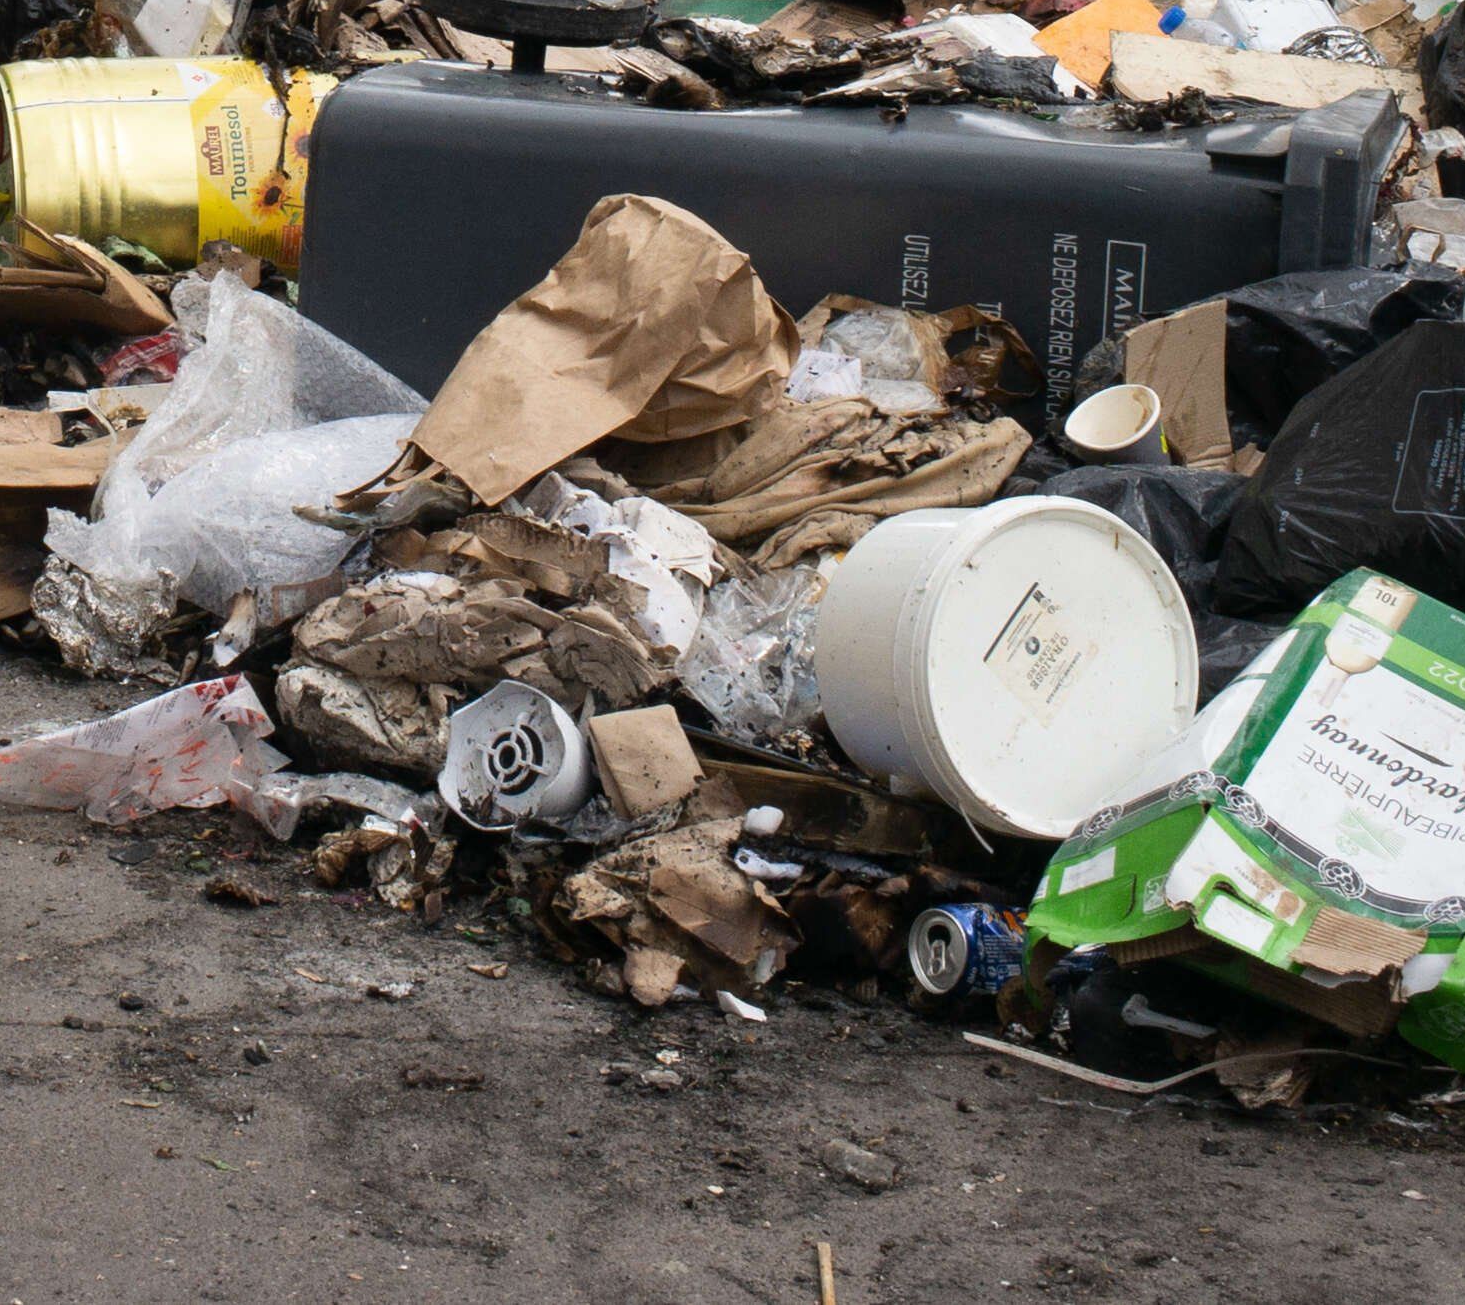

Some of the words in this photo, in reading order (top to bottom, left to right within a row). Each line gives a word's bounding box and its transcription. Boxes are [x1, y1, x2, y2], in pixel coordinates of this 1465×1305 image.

[209, 126, 223, 176] MAUREL
[231, 104, 248, 201] Tournesol
[1054, 233, 1078, 253] NE
[902, 234, 931, 298] UTILISEZ
[1050, 253, 1077, 332] DEPOSEZ
[1048, 331, 1073, 368] RIEN
[1047, 368, 1071, 400] SUR
[1374, 586, 1399, 608] 10L
